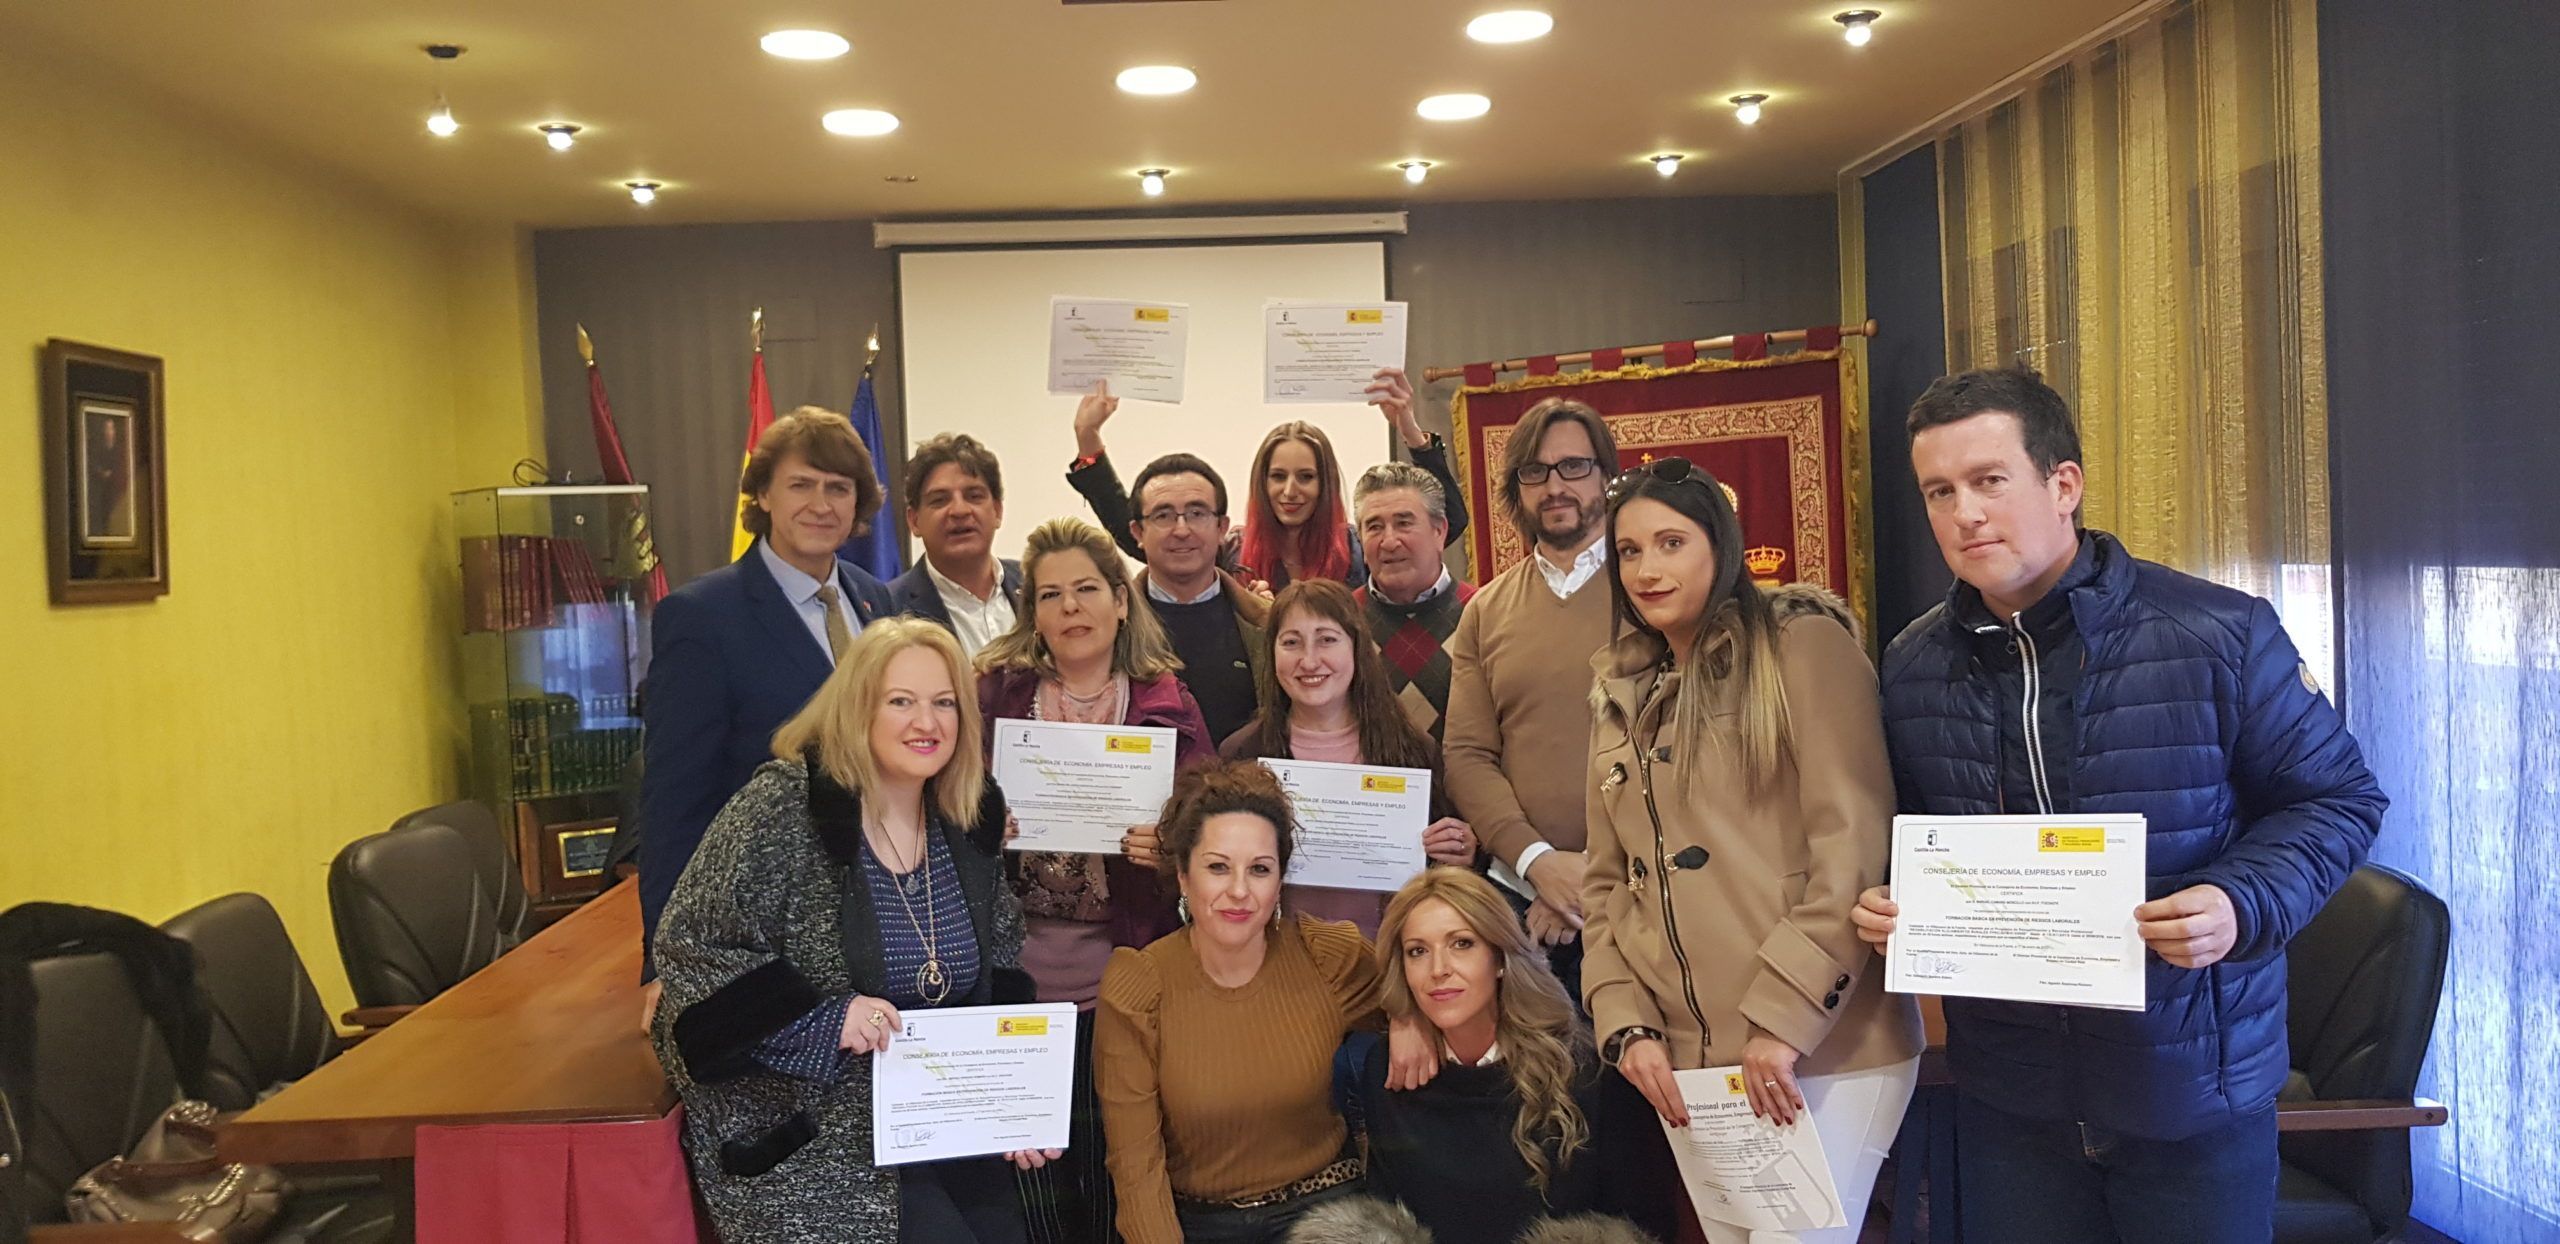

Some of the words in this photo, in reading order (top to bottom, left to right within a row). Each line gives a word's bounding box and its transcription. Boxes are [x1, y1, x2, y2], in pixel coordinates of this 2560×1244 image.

[1922, 866, 1968, 875] CONSEJERÍA
[1968, 867, 1979, 875] DE
[1981, 867, 2023, 876] ECONOMÍA,
[2024, 868, 2066, 876] EMPRESAS
[2067, 868, 2073, 876] Y
[2074, 869, 2107, 877] EMPLEO
[1023, 1046, 1049, 1054] EMPLEO
[1686, 1101, 1719, 1112] Profesional
[1721, 1102, 1738, 1111] para
[1740, 1099, 1747, 1107] el
